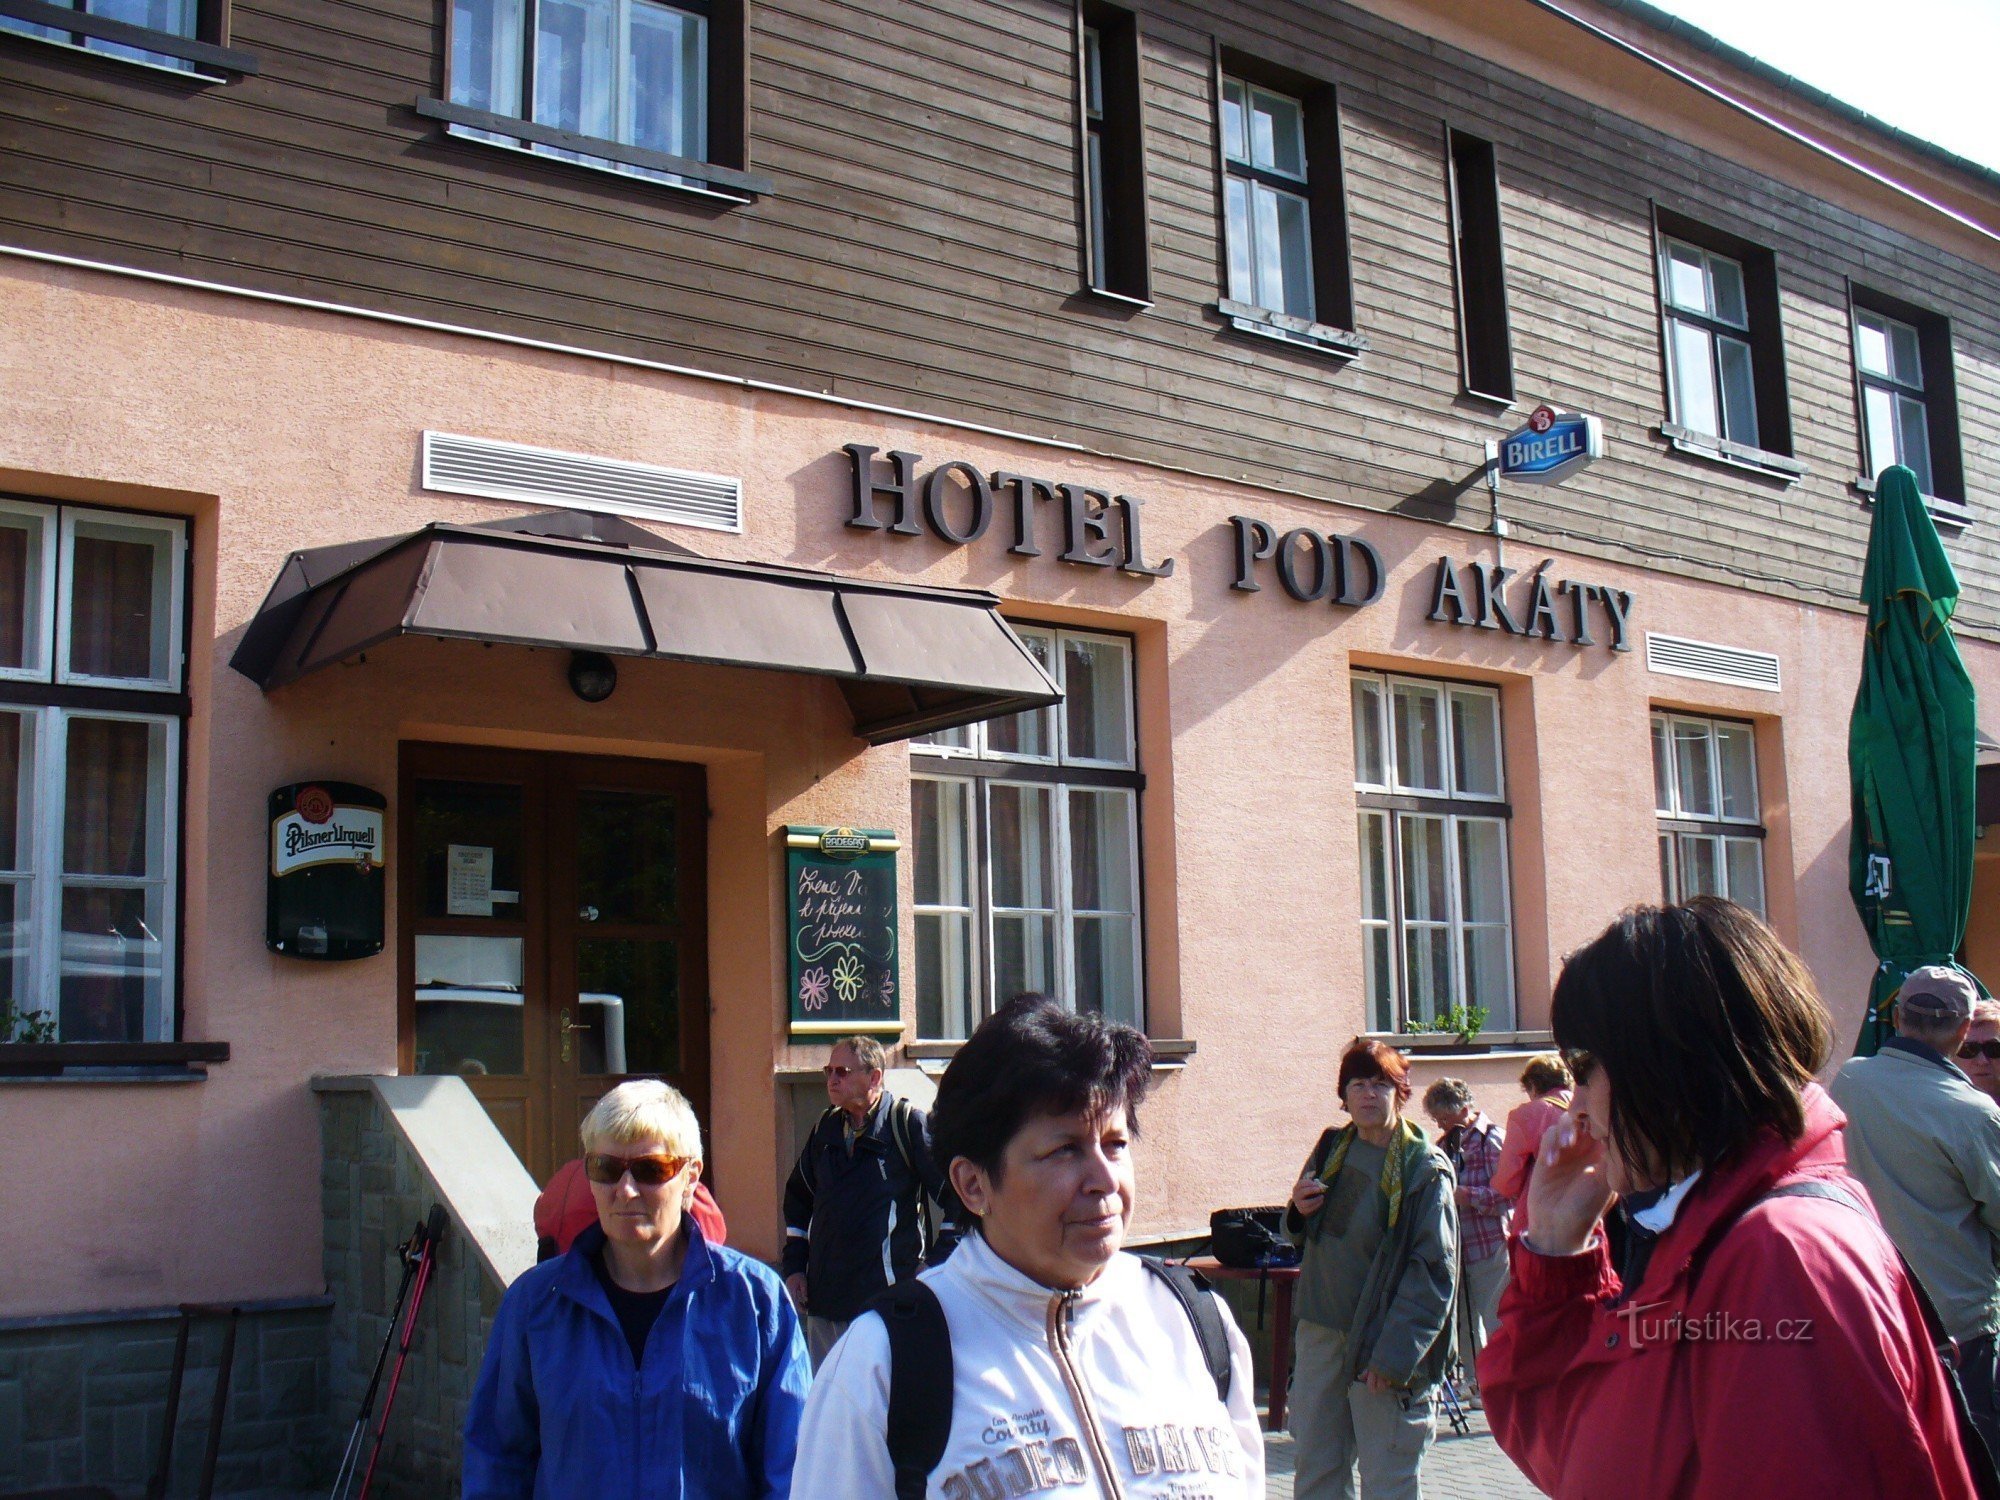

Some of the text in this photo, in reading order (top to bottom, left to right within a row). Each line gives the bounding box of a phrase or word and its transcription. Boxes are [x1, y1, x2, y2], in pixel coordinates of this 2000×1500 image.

[1507, 432, 1582, 468] BIRELL
[842, 443, 1638, 652] HOTEL POD AKÁTY
[286, 822, 375, 857] Pilsner Urquell
[825, 837, 865, 849] RADEGAST
[981, 1419, 1051, 1445] County
